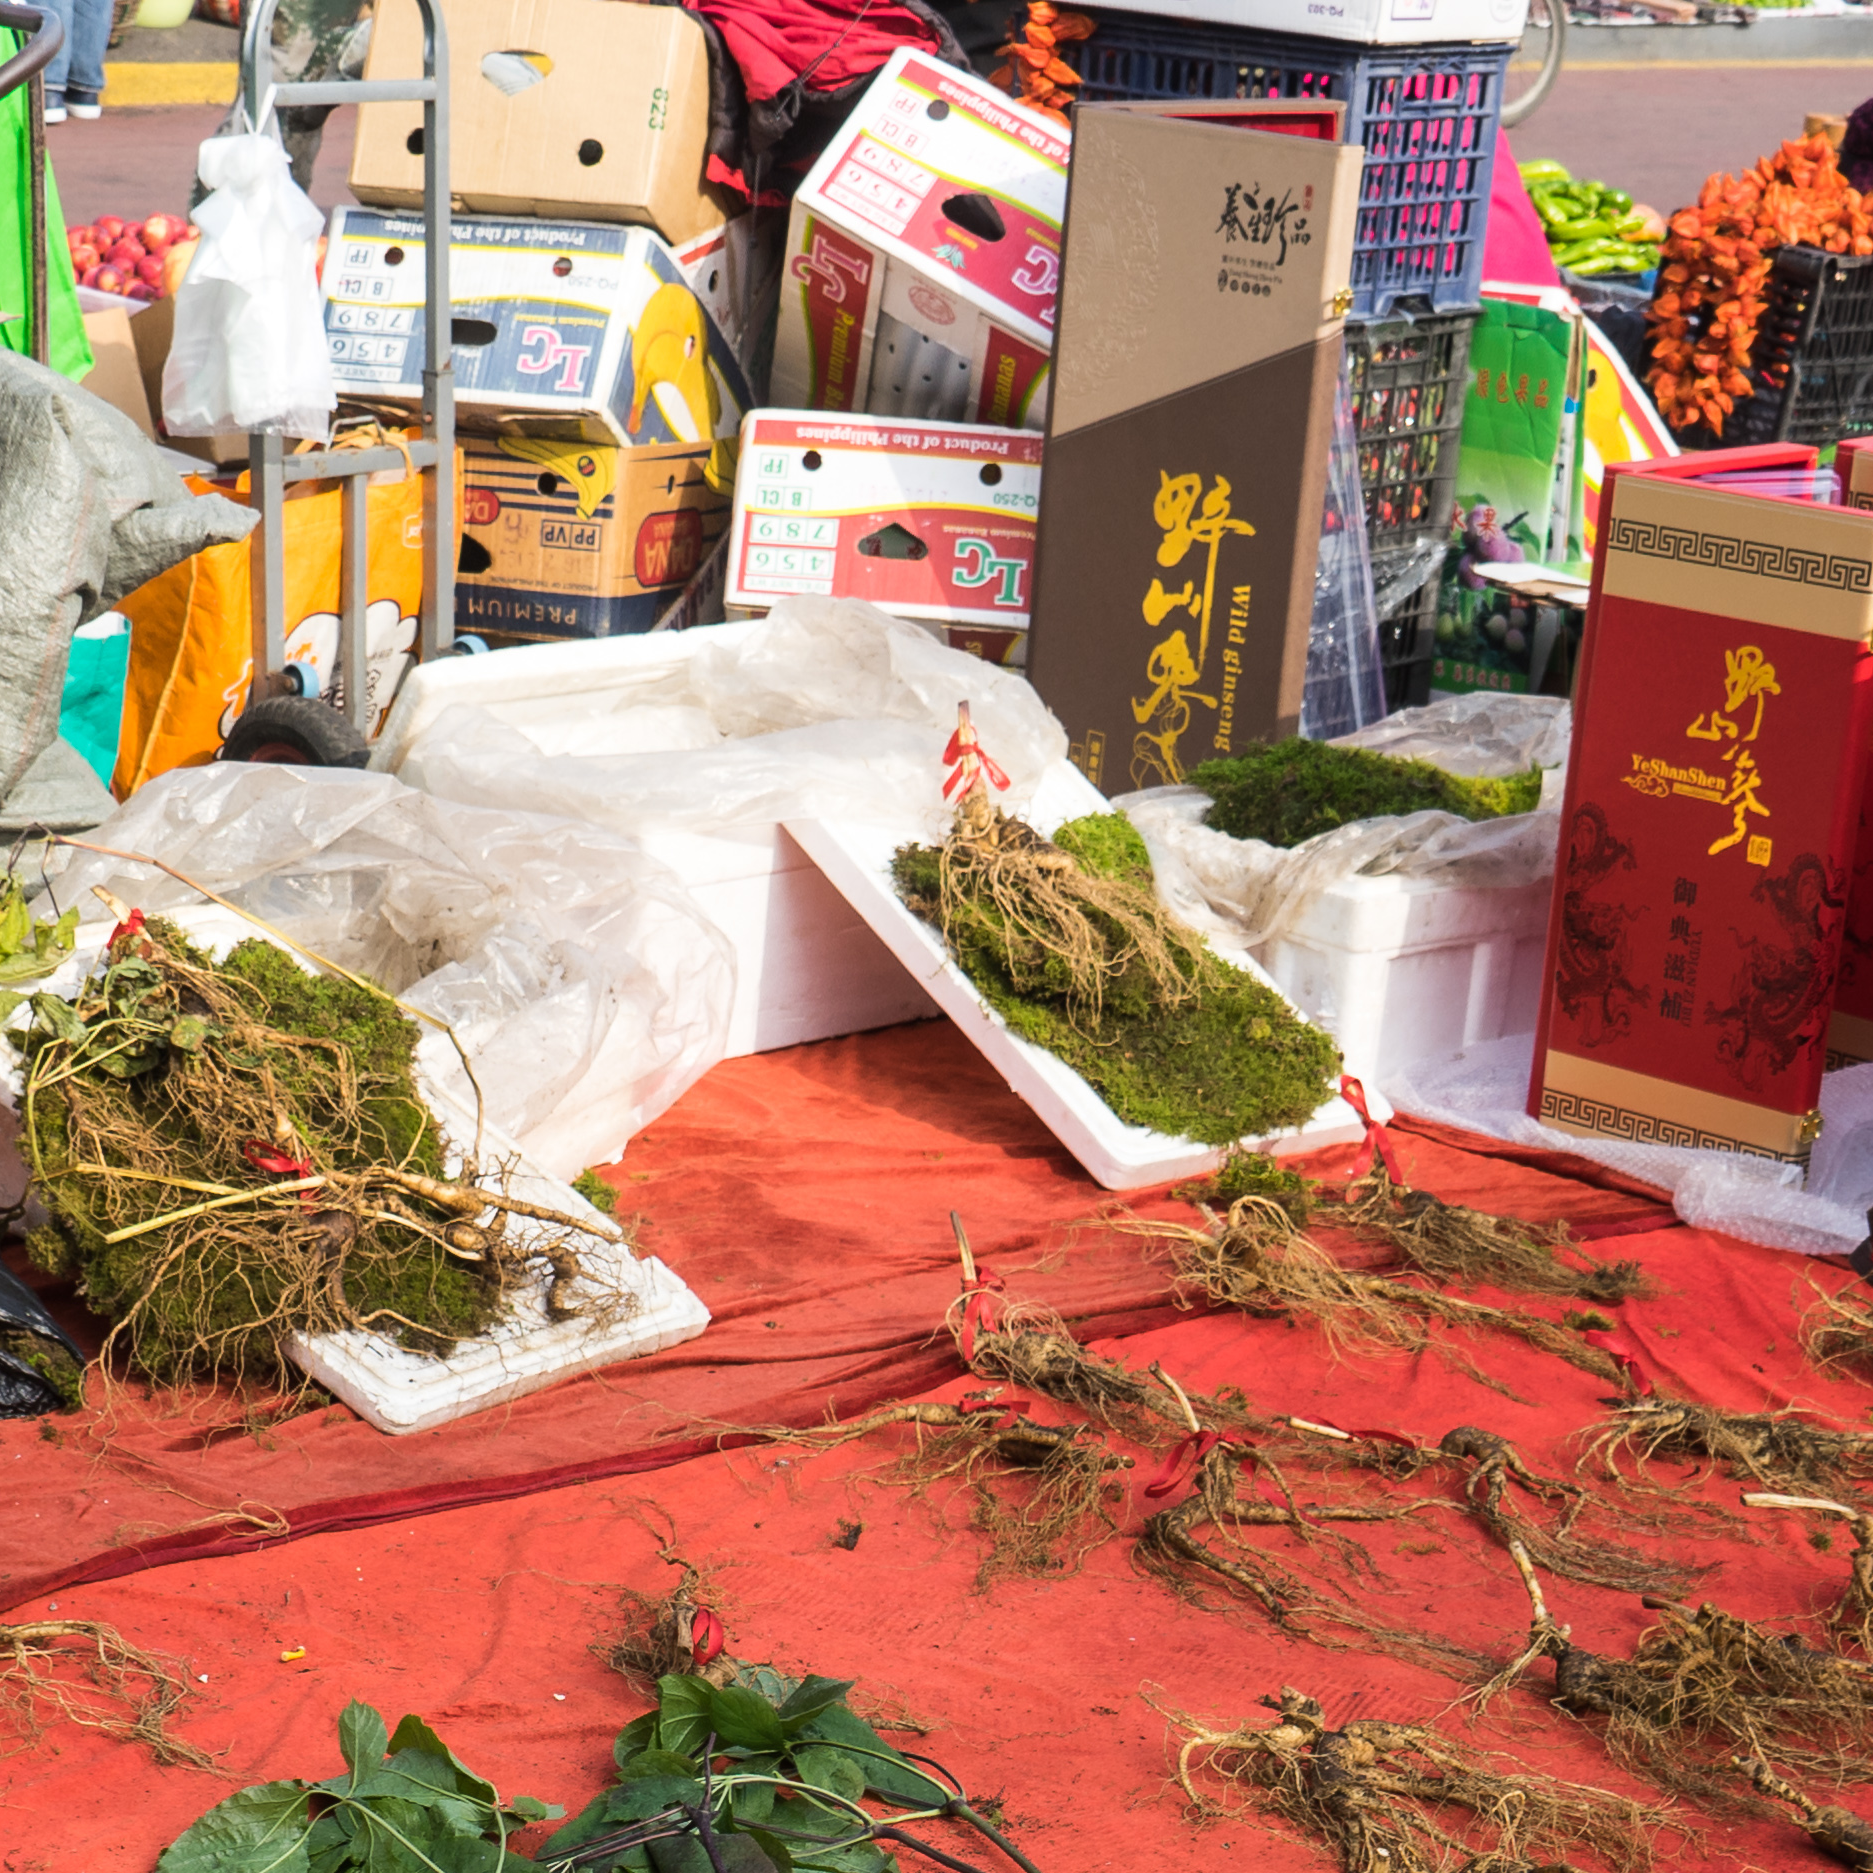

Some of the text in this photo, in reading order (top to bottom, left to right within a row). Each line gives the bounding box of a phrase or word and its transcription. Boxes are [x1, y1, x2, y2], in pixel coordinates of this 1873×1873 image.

[937, 79, 1018, 134] Philippines
[904, 131, 919, 148] B
[1019, 123, 1043, 148] the
[476, 222, 500, 241] the
[502, 224, 522, 242] of
[525, 225, 587, 247] Product
[348, 248, 369, 264] FP
[791, 234, 870, 305] LC
[372, 278, 384, 295] B
[338, 309, 403, 330] 7 8 9
[332, 338, 398, 360] 4 5 6
[516, 325, 592, 392] LC
[796, 425, 1010, 454] Product of the Philippines
[763, 458, 784, 474] FP
[761, 489, 803, 506] B CL
[993, 492, 1038, 508] Q-250
[543, 523, 567, 544] VP
[573, 525, 597, 546] PP
[759, 520, 827, 541] 7 8 9
[755, 551, 825, 571] 4 5 6
[952, 537, 1028, 607] LC
[468, 598, 576, 625] PREMIUM
[1213, 584, 1251, 752] Wild ginseng
[1631, 752, 1727, 792] YeShanShen
